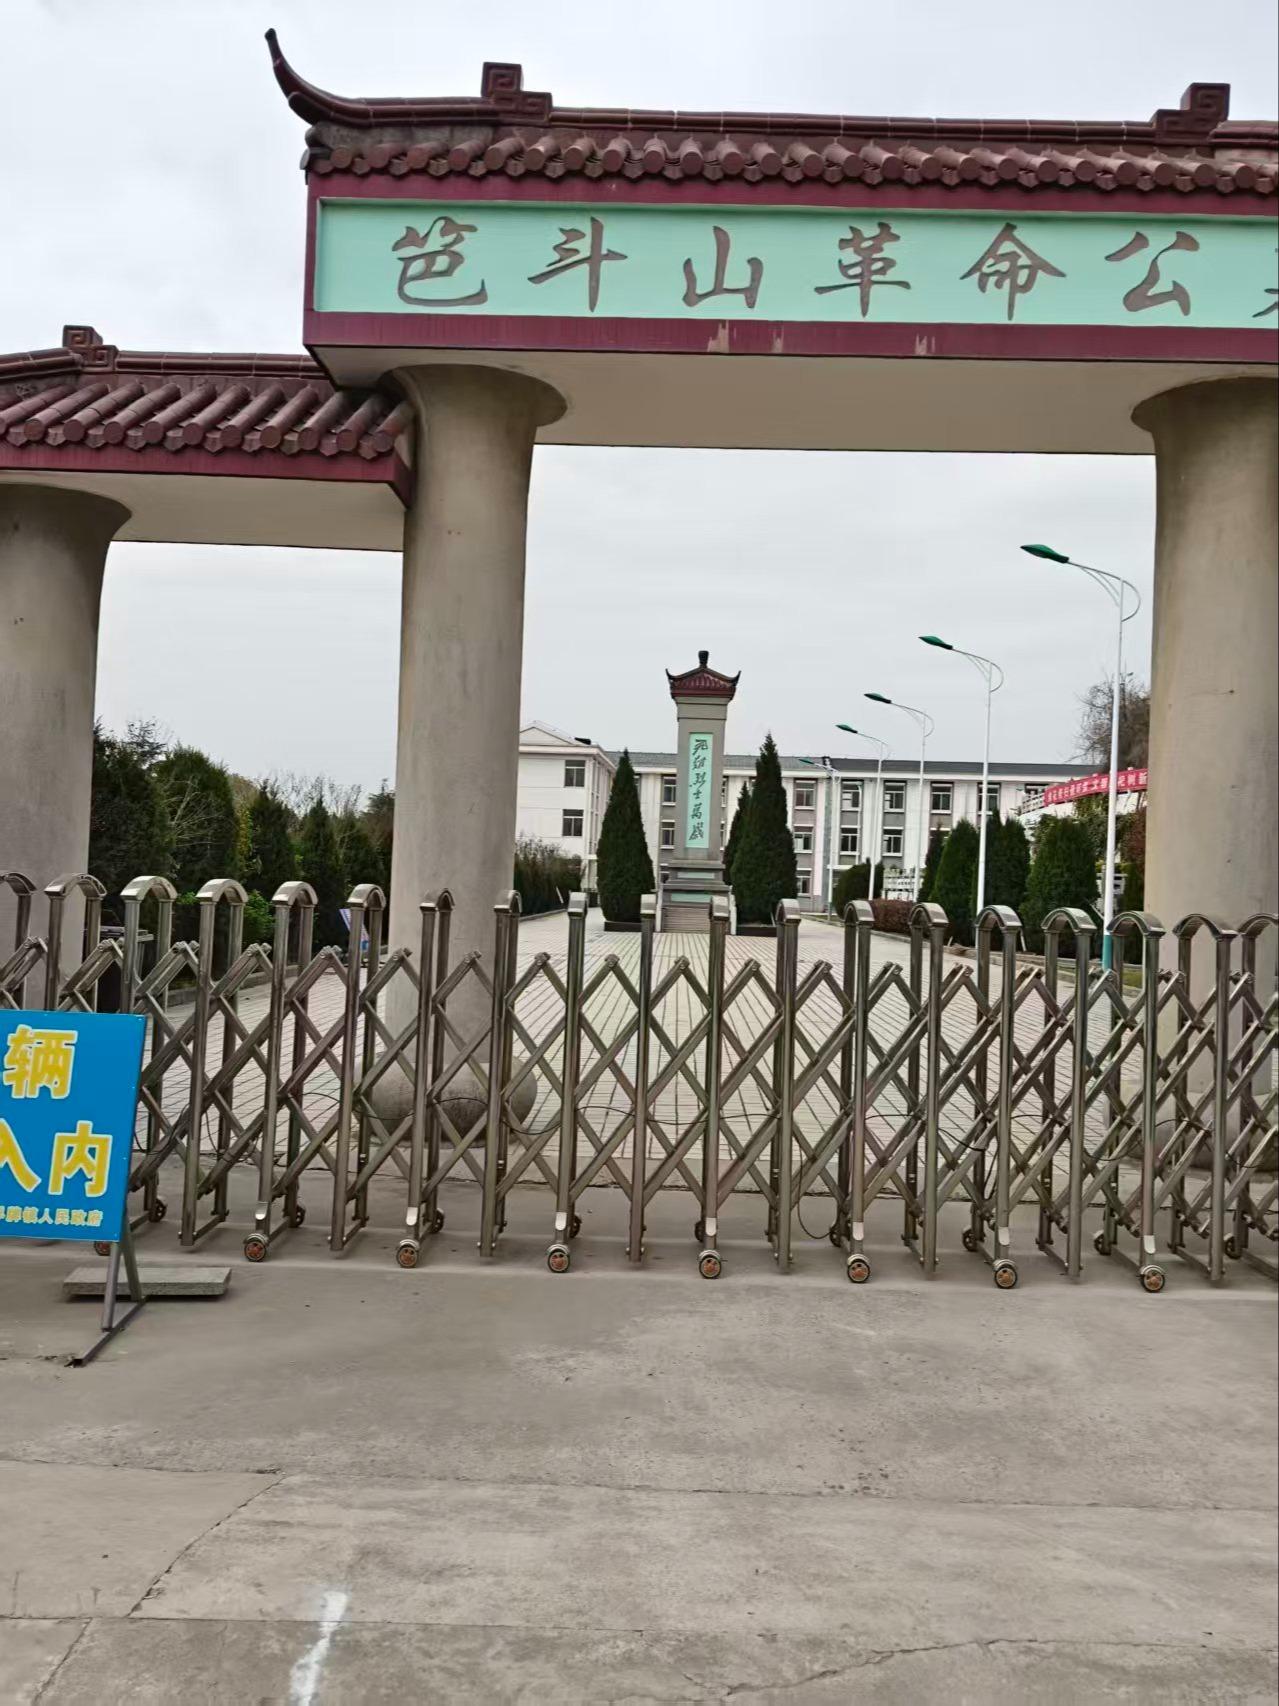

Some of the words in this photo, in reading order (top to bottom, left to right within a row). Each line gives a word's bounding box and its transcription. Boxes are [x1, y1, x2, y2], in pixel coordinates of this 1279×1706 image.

[392, 216, 1278, 321] 笆斗山革命公
[3, 1024, 78, 1099] 辆
